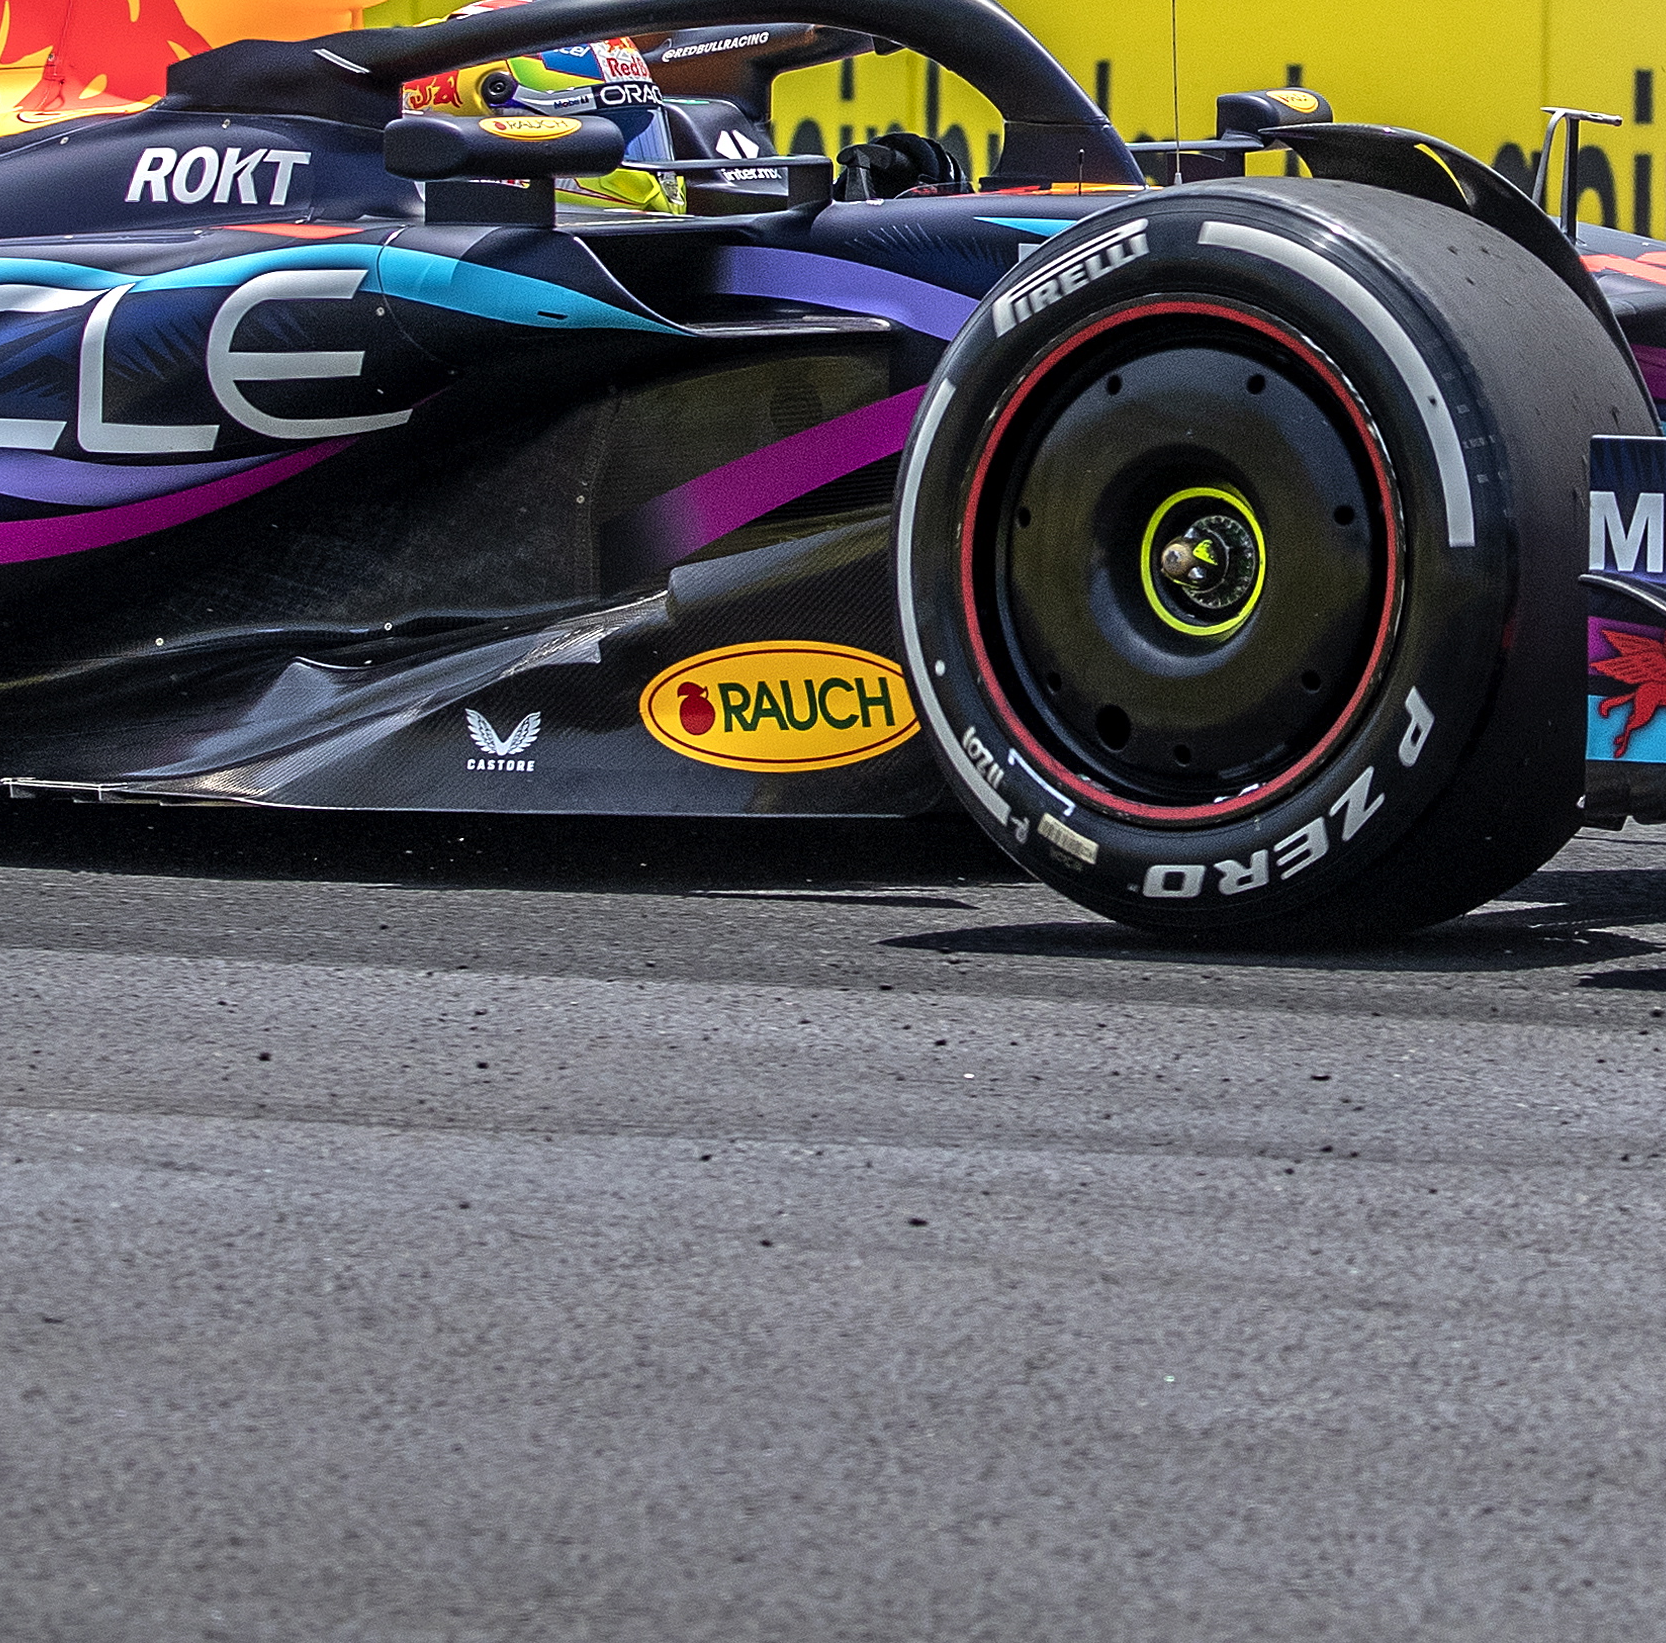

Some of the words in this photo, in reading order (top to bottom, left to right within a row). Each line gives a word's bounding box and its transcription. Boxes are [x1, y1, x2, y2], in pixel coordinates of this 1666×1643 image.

[662, 31, 770, 63] @REDBULLRACING
[124, 145, 312, 207] ROKT
[992, 217, 1150, 338] PIRELLI
[721, 676, 896, 734] RAUCH
[466, 758, 537, 772] CASTORE
[1140, 782, 1386, 902] ZERO
